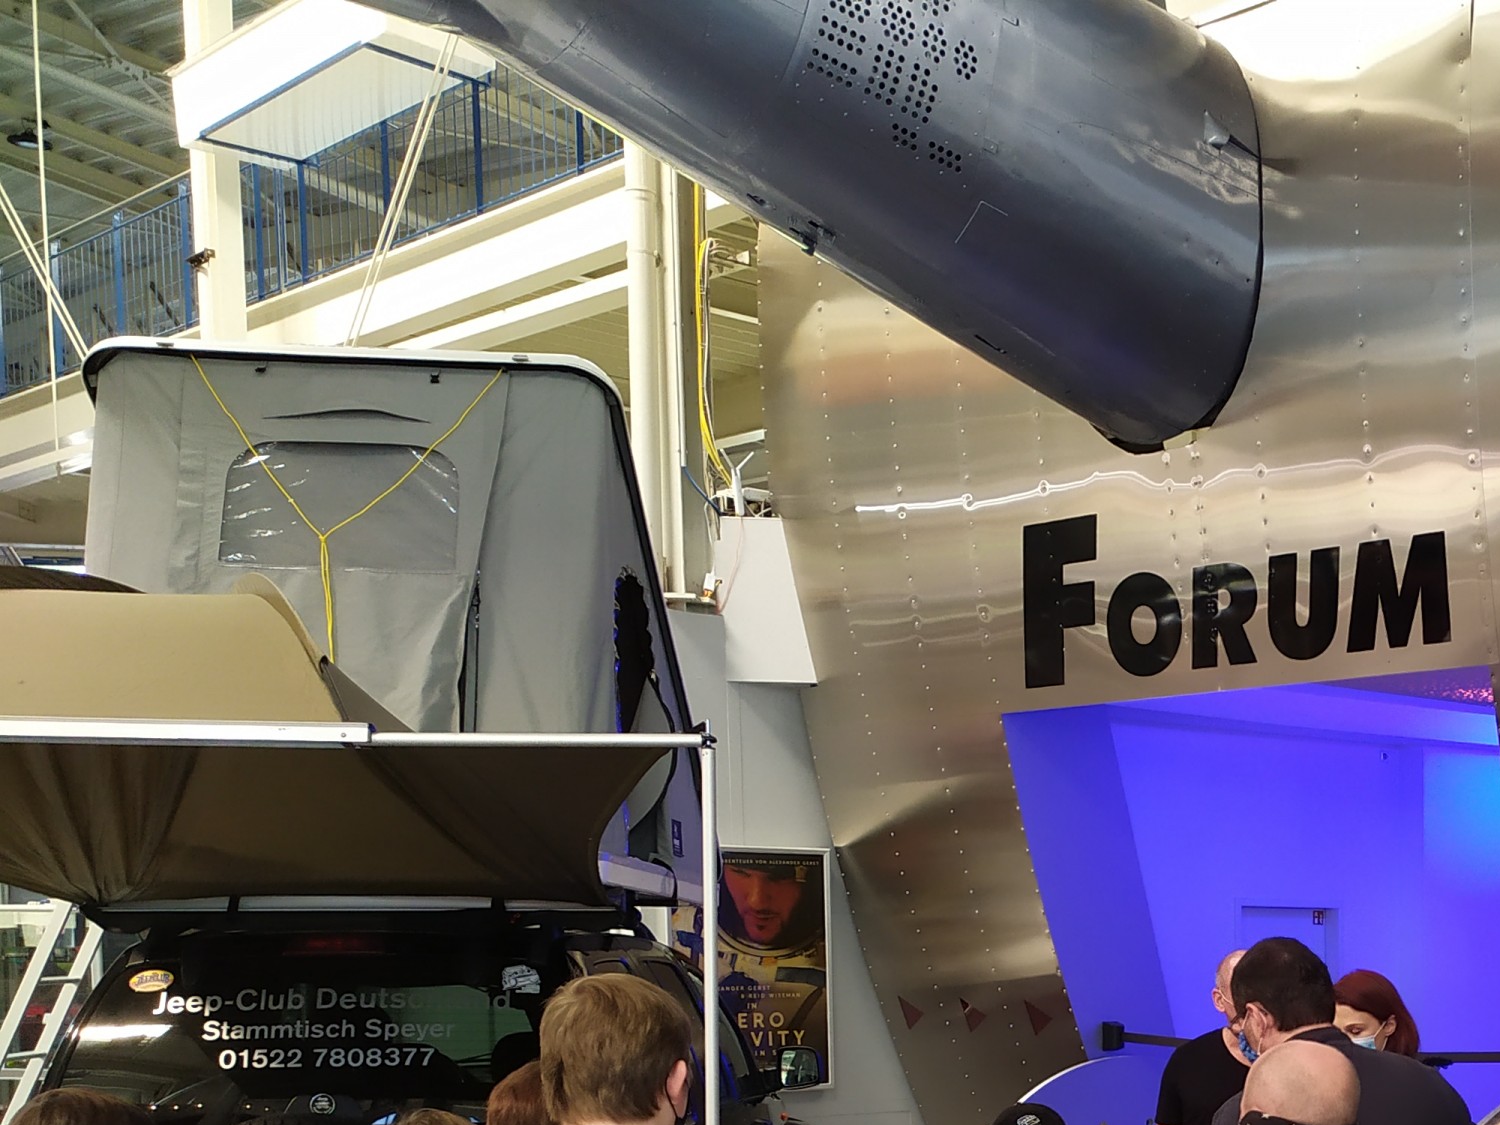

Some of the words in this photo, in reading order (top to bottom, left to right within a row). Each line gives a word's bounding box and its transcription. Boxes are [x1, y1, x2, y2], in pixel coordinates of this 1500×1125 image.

[1022, 513, 1452, 689] FORUM
[152, 987, 305, 1015] Jeep-Club
[746, 1002, 758, 1010] IN
[201, 1019, 357, 1042] Stammtisch
[364, 1018, 455, 1045] Speyer
[737, 1011, 785, 1029] ERO
[750, 1030, 807, 1047] VITY
[217, 1049, 302, 1070] 01522
[312, 1047, 435, 1069] 7808377
